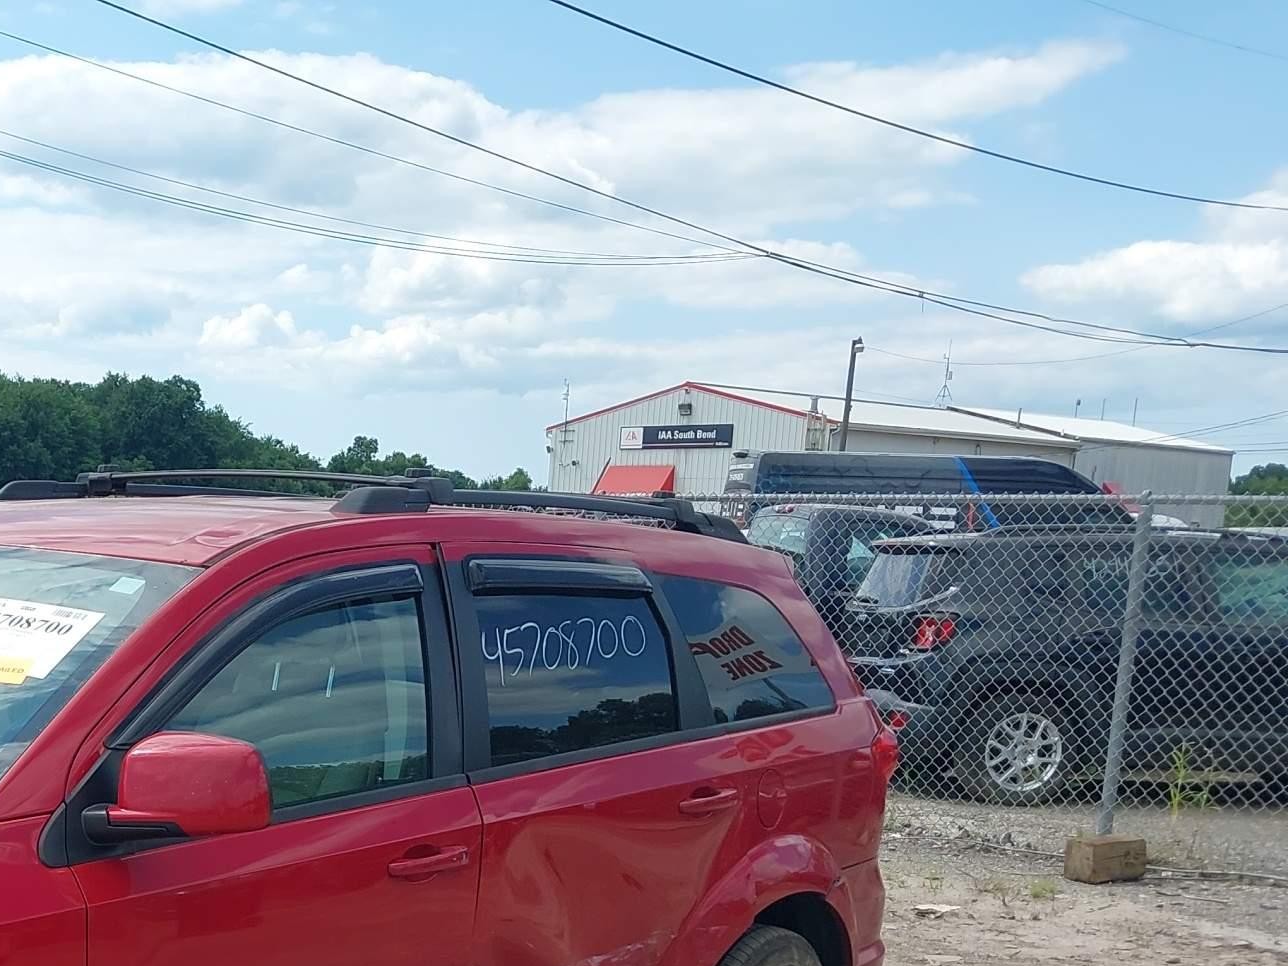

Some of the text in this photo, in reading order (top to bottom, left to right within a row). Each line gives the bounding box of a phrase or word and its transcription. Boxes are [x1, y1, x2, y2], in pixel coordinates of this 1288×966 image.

[658, 430, 672, 440] IAA
[674, 430, 695, 440] South
[481, 615, 646, 686] 45708700
